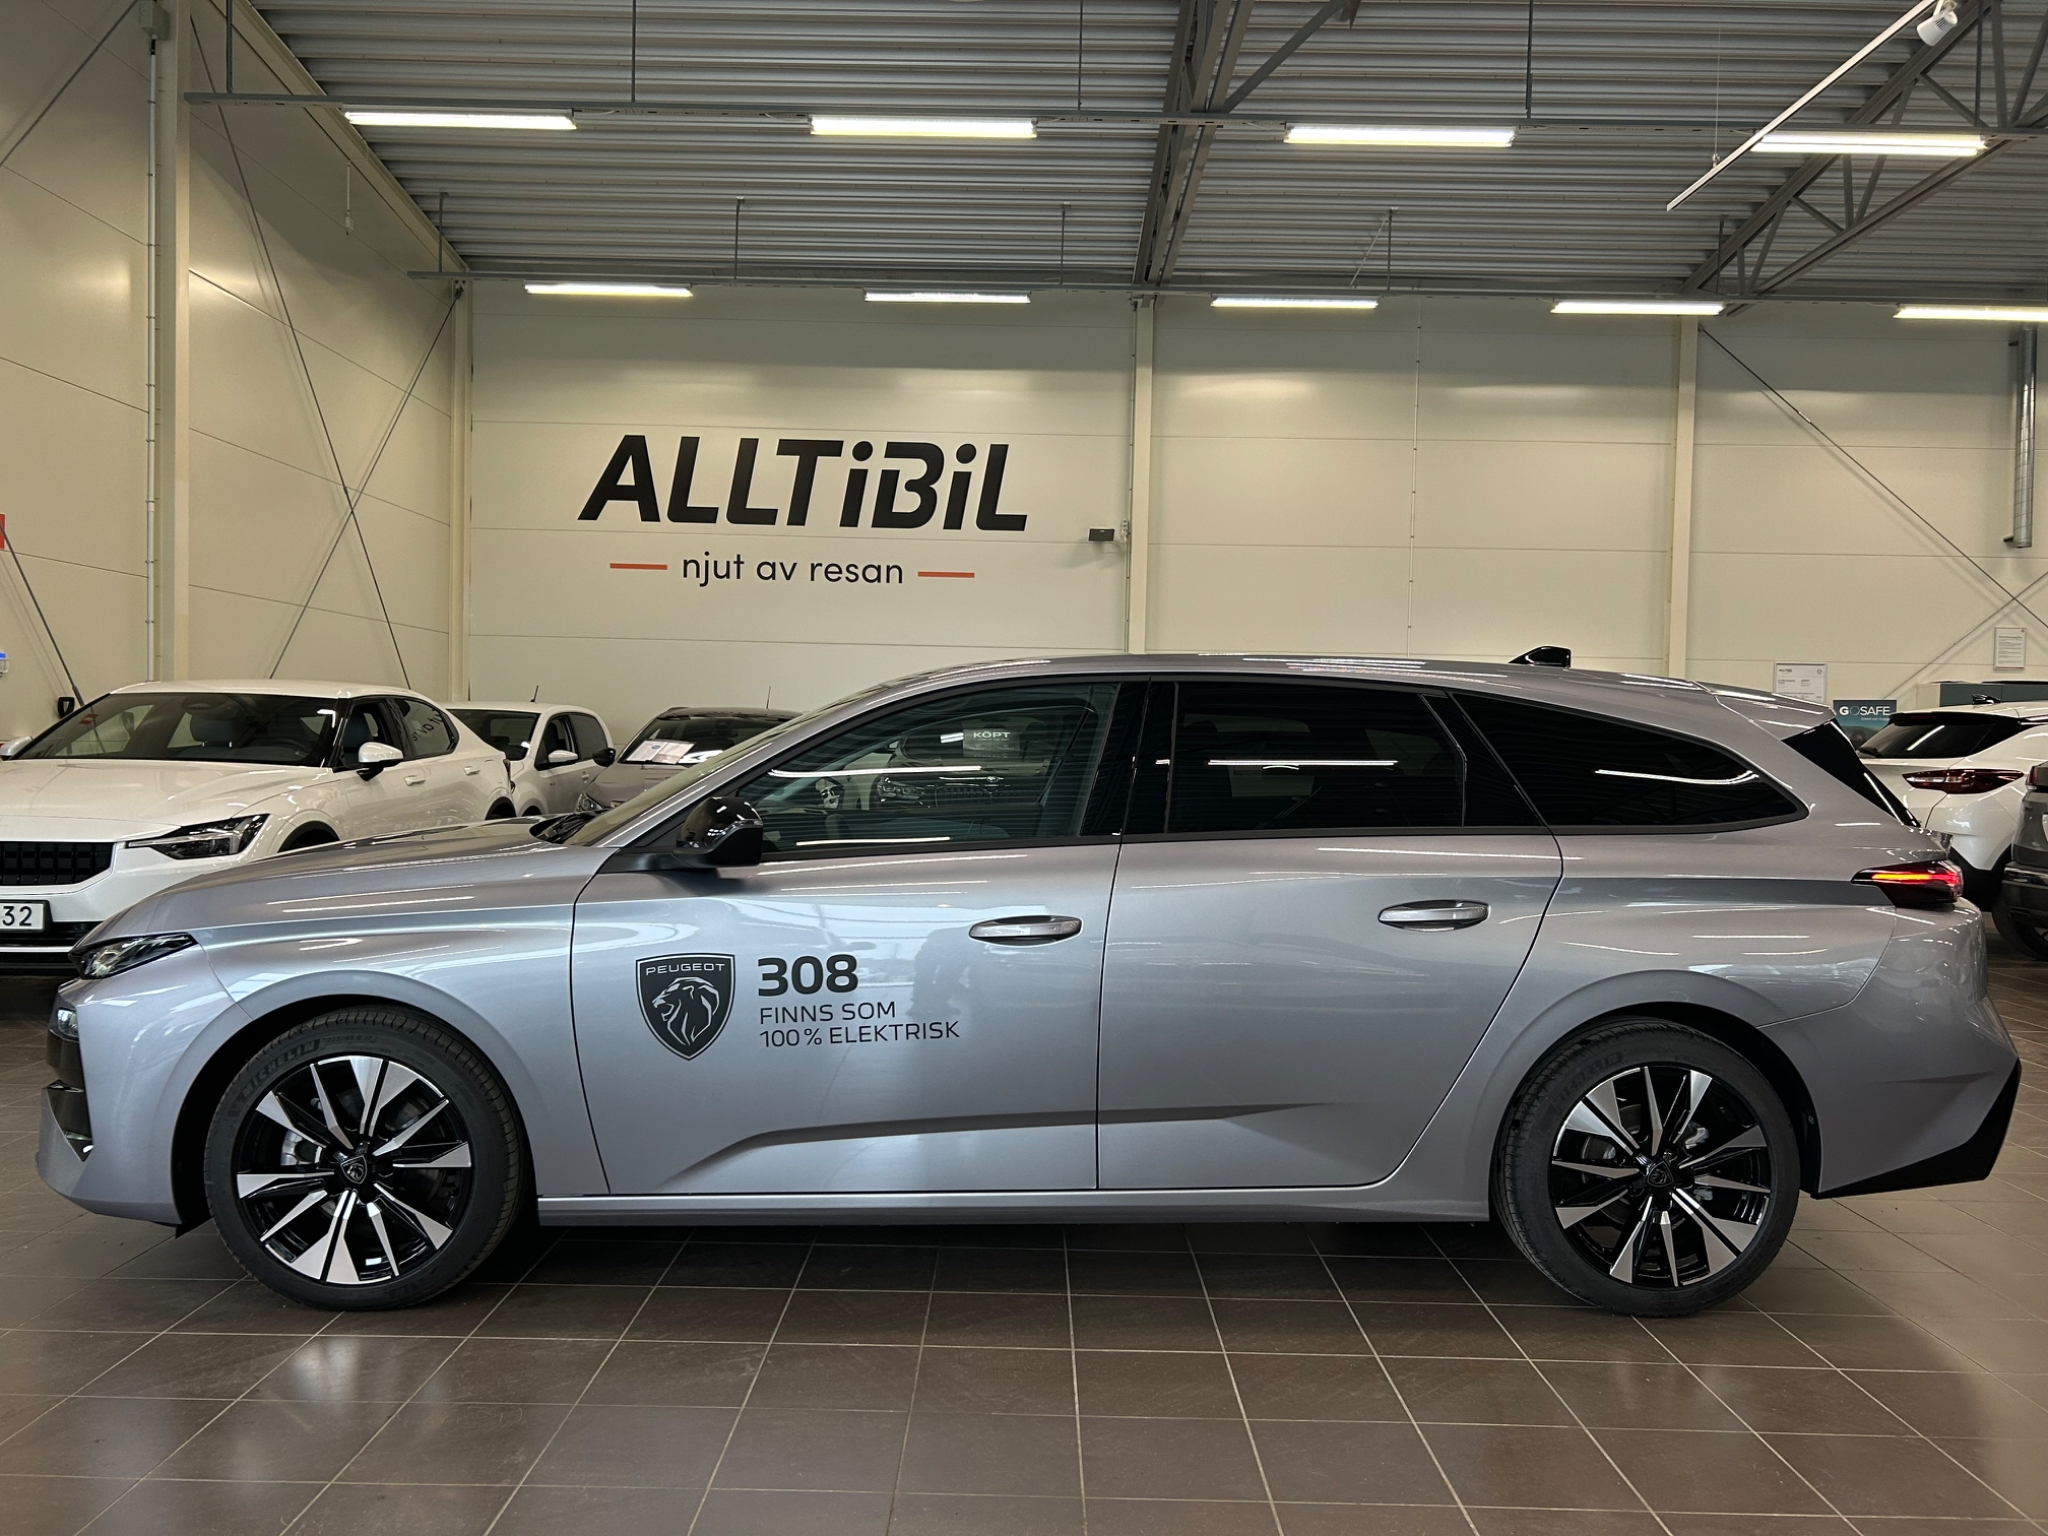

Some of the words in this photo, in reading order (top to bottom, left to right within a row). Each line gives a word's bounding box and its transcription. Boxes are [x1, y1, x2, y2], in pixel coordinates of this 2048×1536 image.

[683, 551, 746, 588] njut
[756, 561, 798, 582] av
[810, 562, 904, 585] resan
[973, 731, 1011, 739] KÖPT
[645, 963, 727, 976] PEUGEOT
[757, 954, 860, 997] 308
[760, 1004, 835, 1025] FINNS
[841, 1001, 897, 1021] SOM
[829, 1020, 961, 1045] ELEKTRISK
[242, 1040, 317, 1099] MICHELIN
